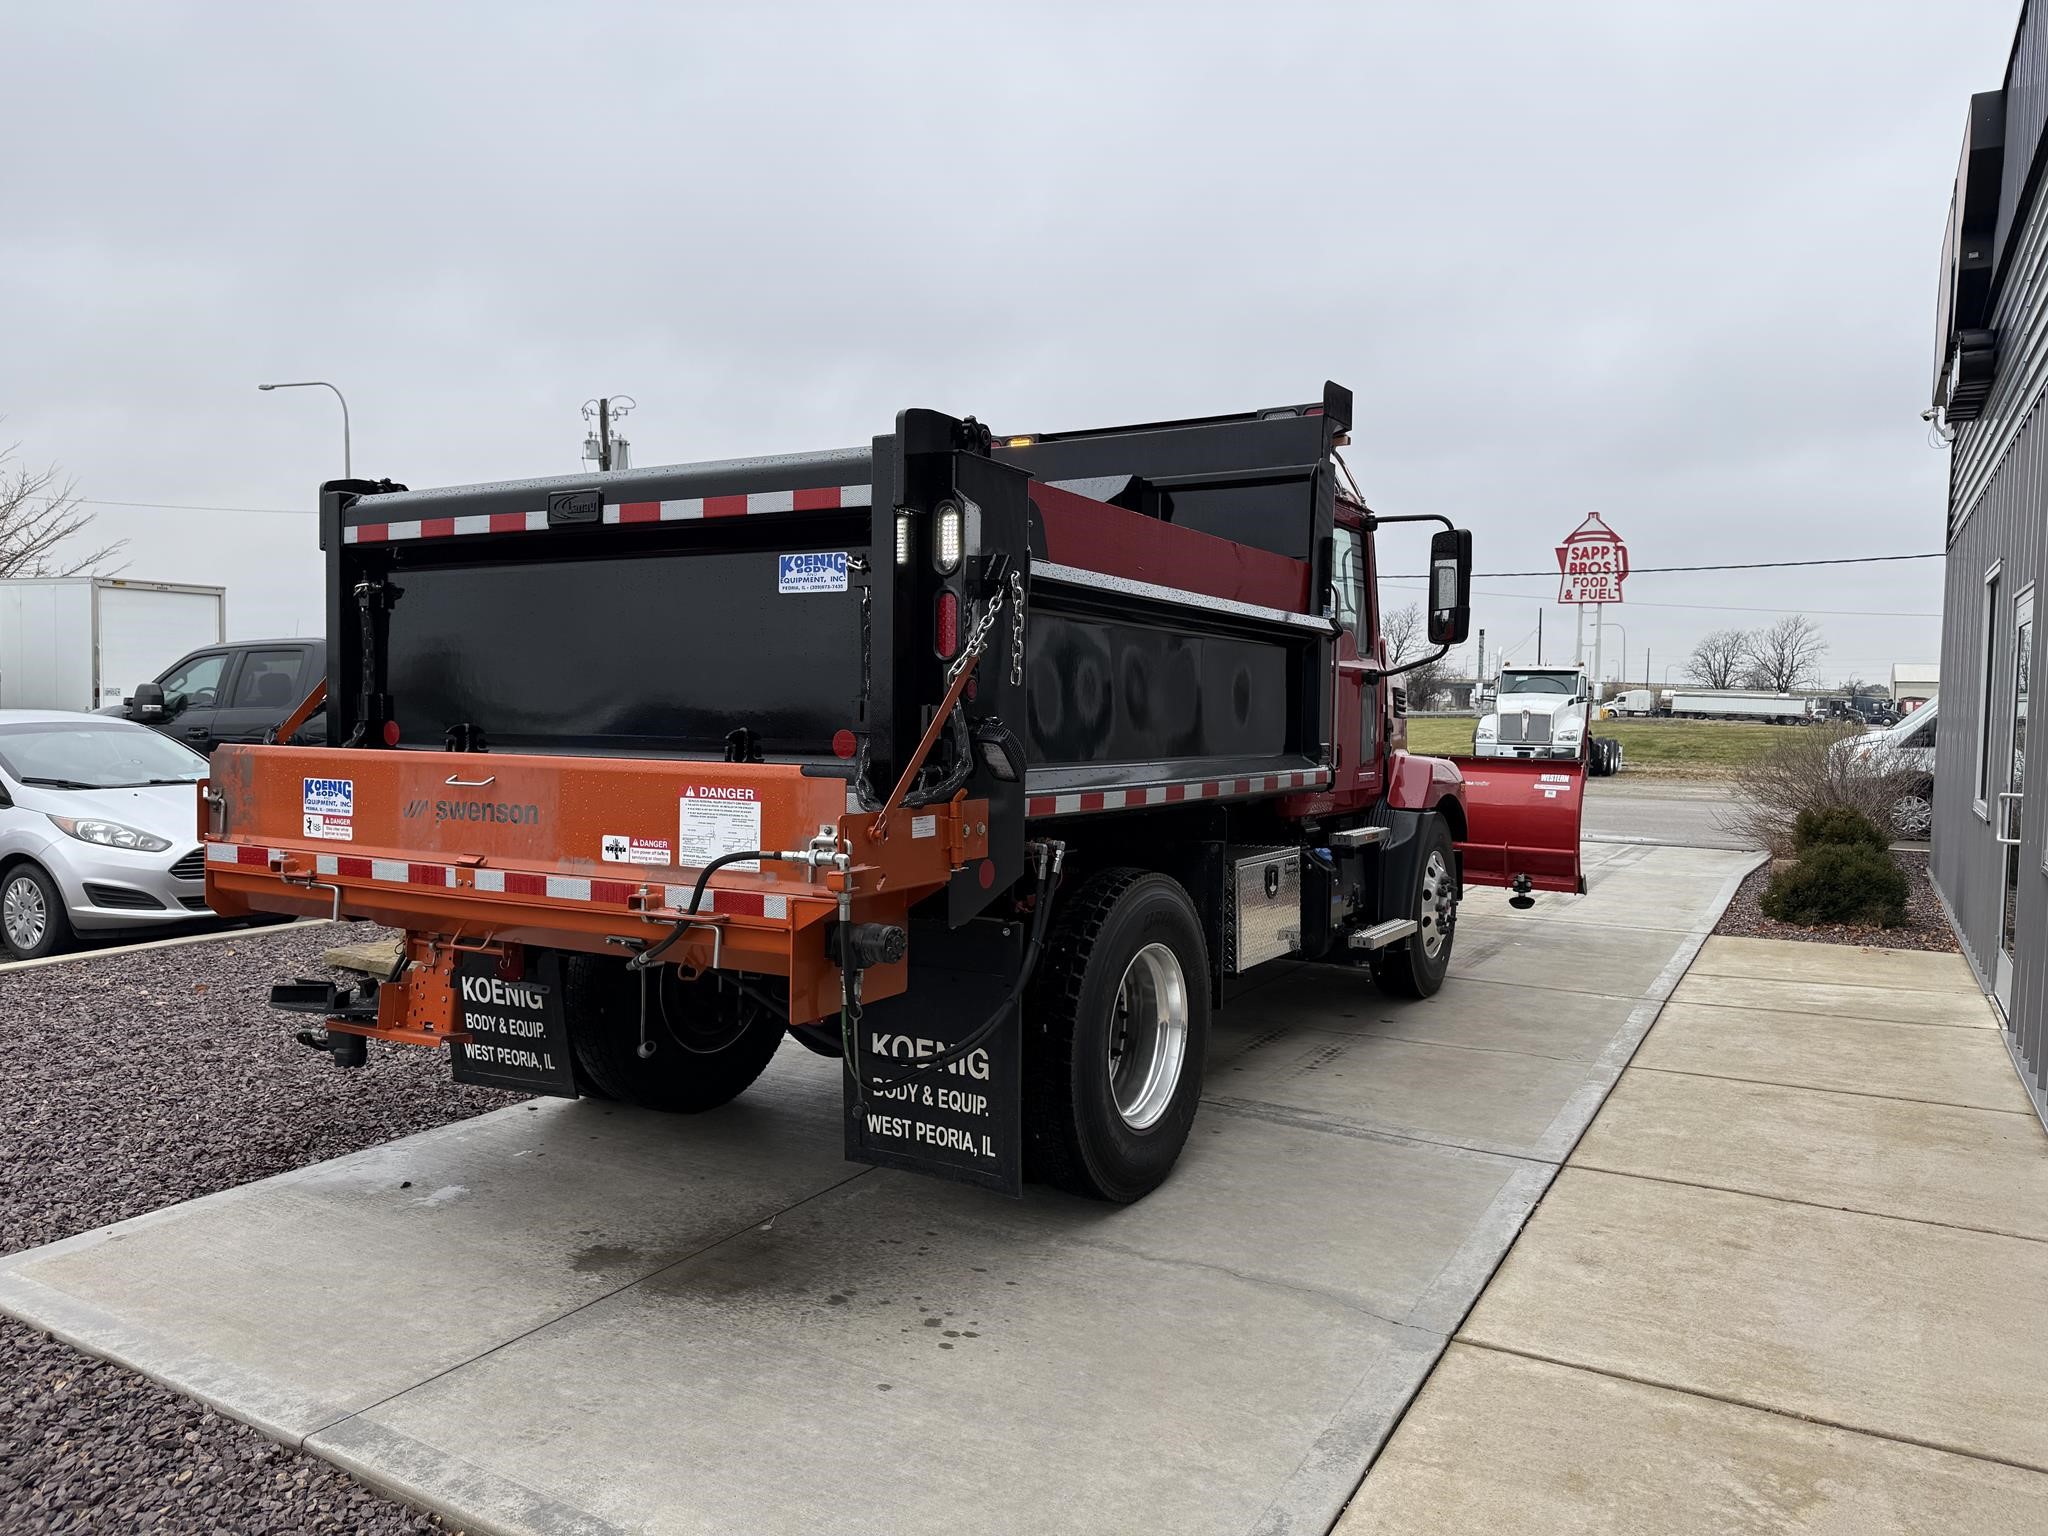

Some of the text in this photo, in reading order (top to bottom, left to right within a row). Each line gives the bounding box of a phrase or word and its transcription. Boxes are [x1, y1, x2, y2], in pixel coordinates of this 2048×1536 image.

[1572, 546, 1610, 560] SAPP
[780, 553, 846, 577] KOENIG
[1564, 588, 1615, 600] & FUEL
[1573, 577, 1608, 588] FOOD
[1540, 774, 1570, 783] WESTERN
[305, 779, 351, 802] KOENIG
[700, 787, 754, 800] DANGER
[436, 800, 538, 825] swenson
[640, 840, 668, 848] DANGER
[461, 976, 544, 1009] KOENIG
[465, 1013, 547, 1039] BODY & EQUIP.
[464, 1043, 555, 1071] WEST PEORIA, IL
[922, 1085, 934, 1106] &
[938, 1088, 989, 1117] EQUIP.
[867, 1114, 996, 1157] WEST PEORIA, IL
